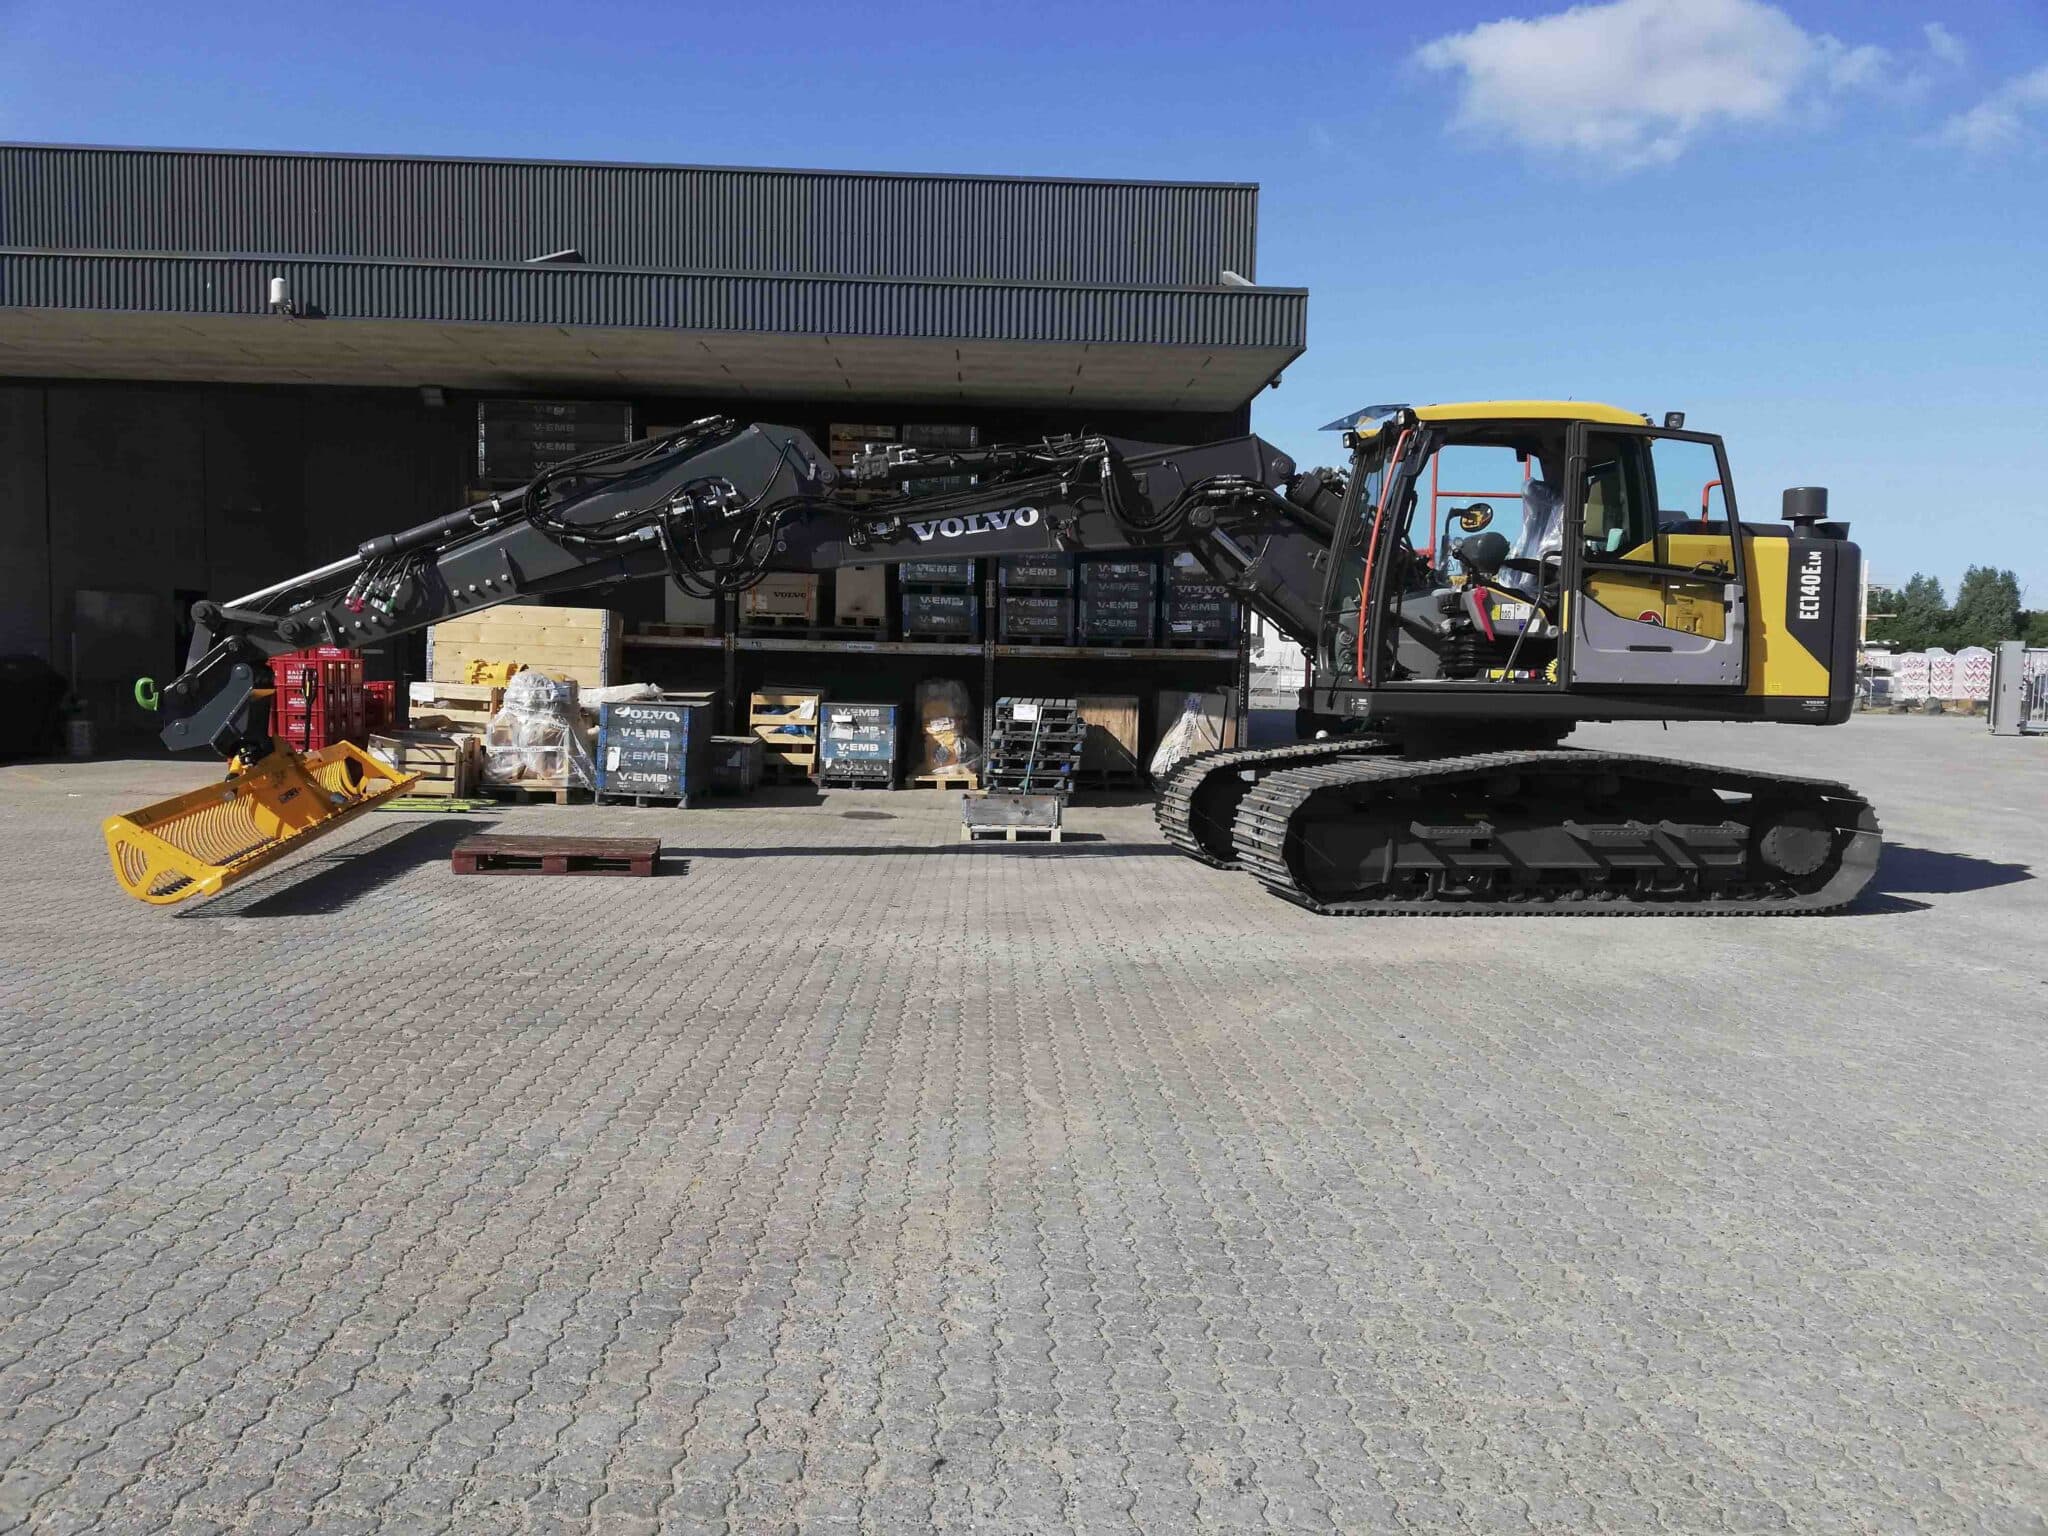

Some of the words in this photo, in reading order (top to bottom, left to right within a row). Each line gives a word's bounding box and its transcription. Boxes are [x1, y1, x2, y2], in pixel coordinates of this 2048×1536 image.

[907, 506, 1039, 542] VOLVO
[1016, 567, 1057, 576] V-EMB
[1097, 601, 1138, 609] V-EMB
[620, 727, 671, 739] V-EMB
[837, 743, 879, 752] V-EMB
[620, 751, 668, 761] V-EMB
[618, 772, 668, 783] V-EMB
